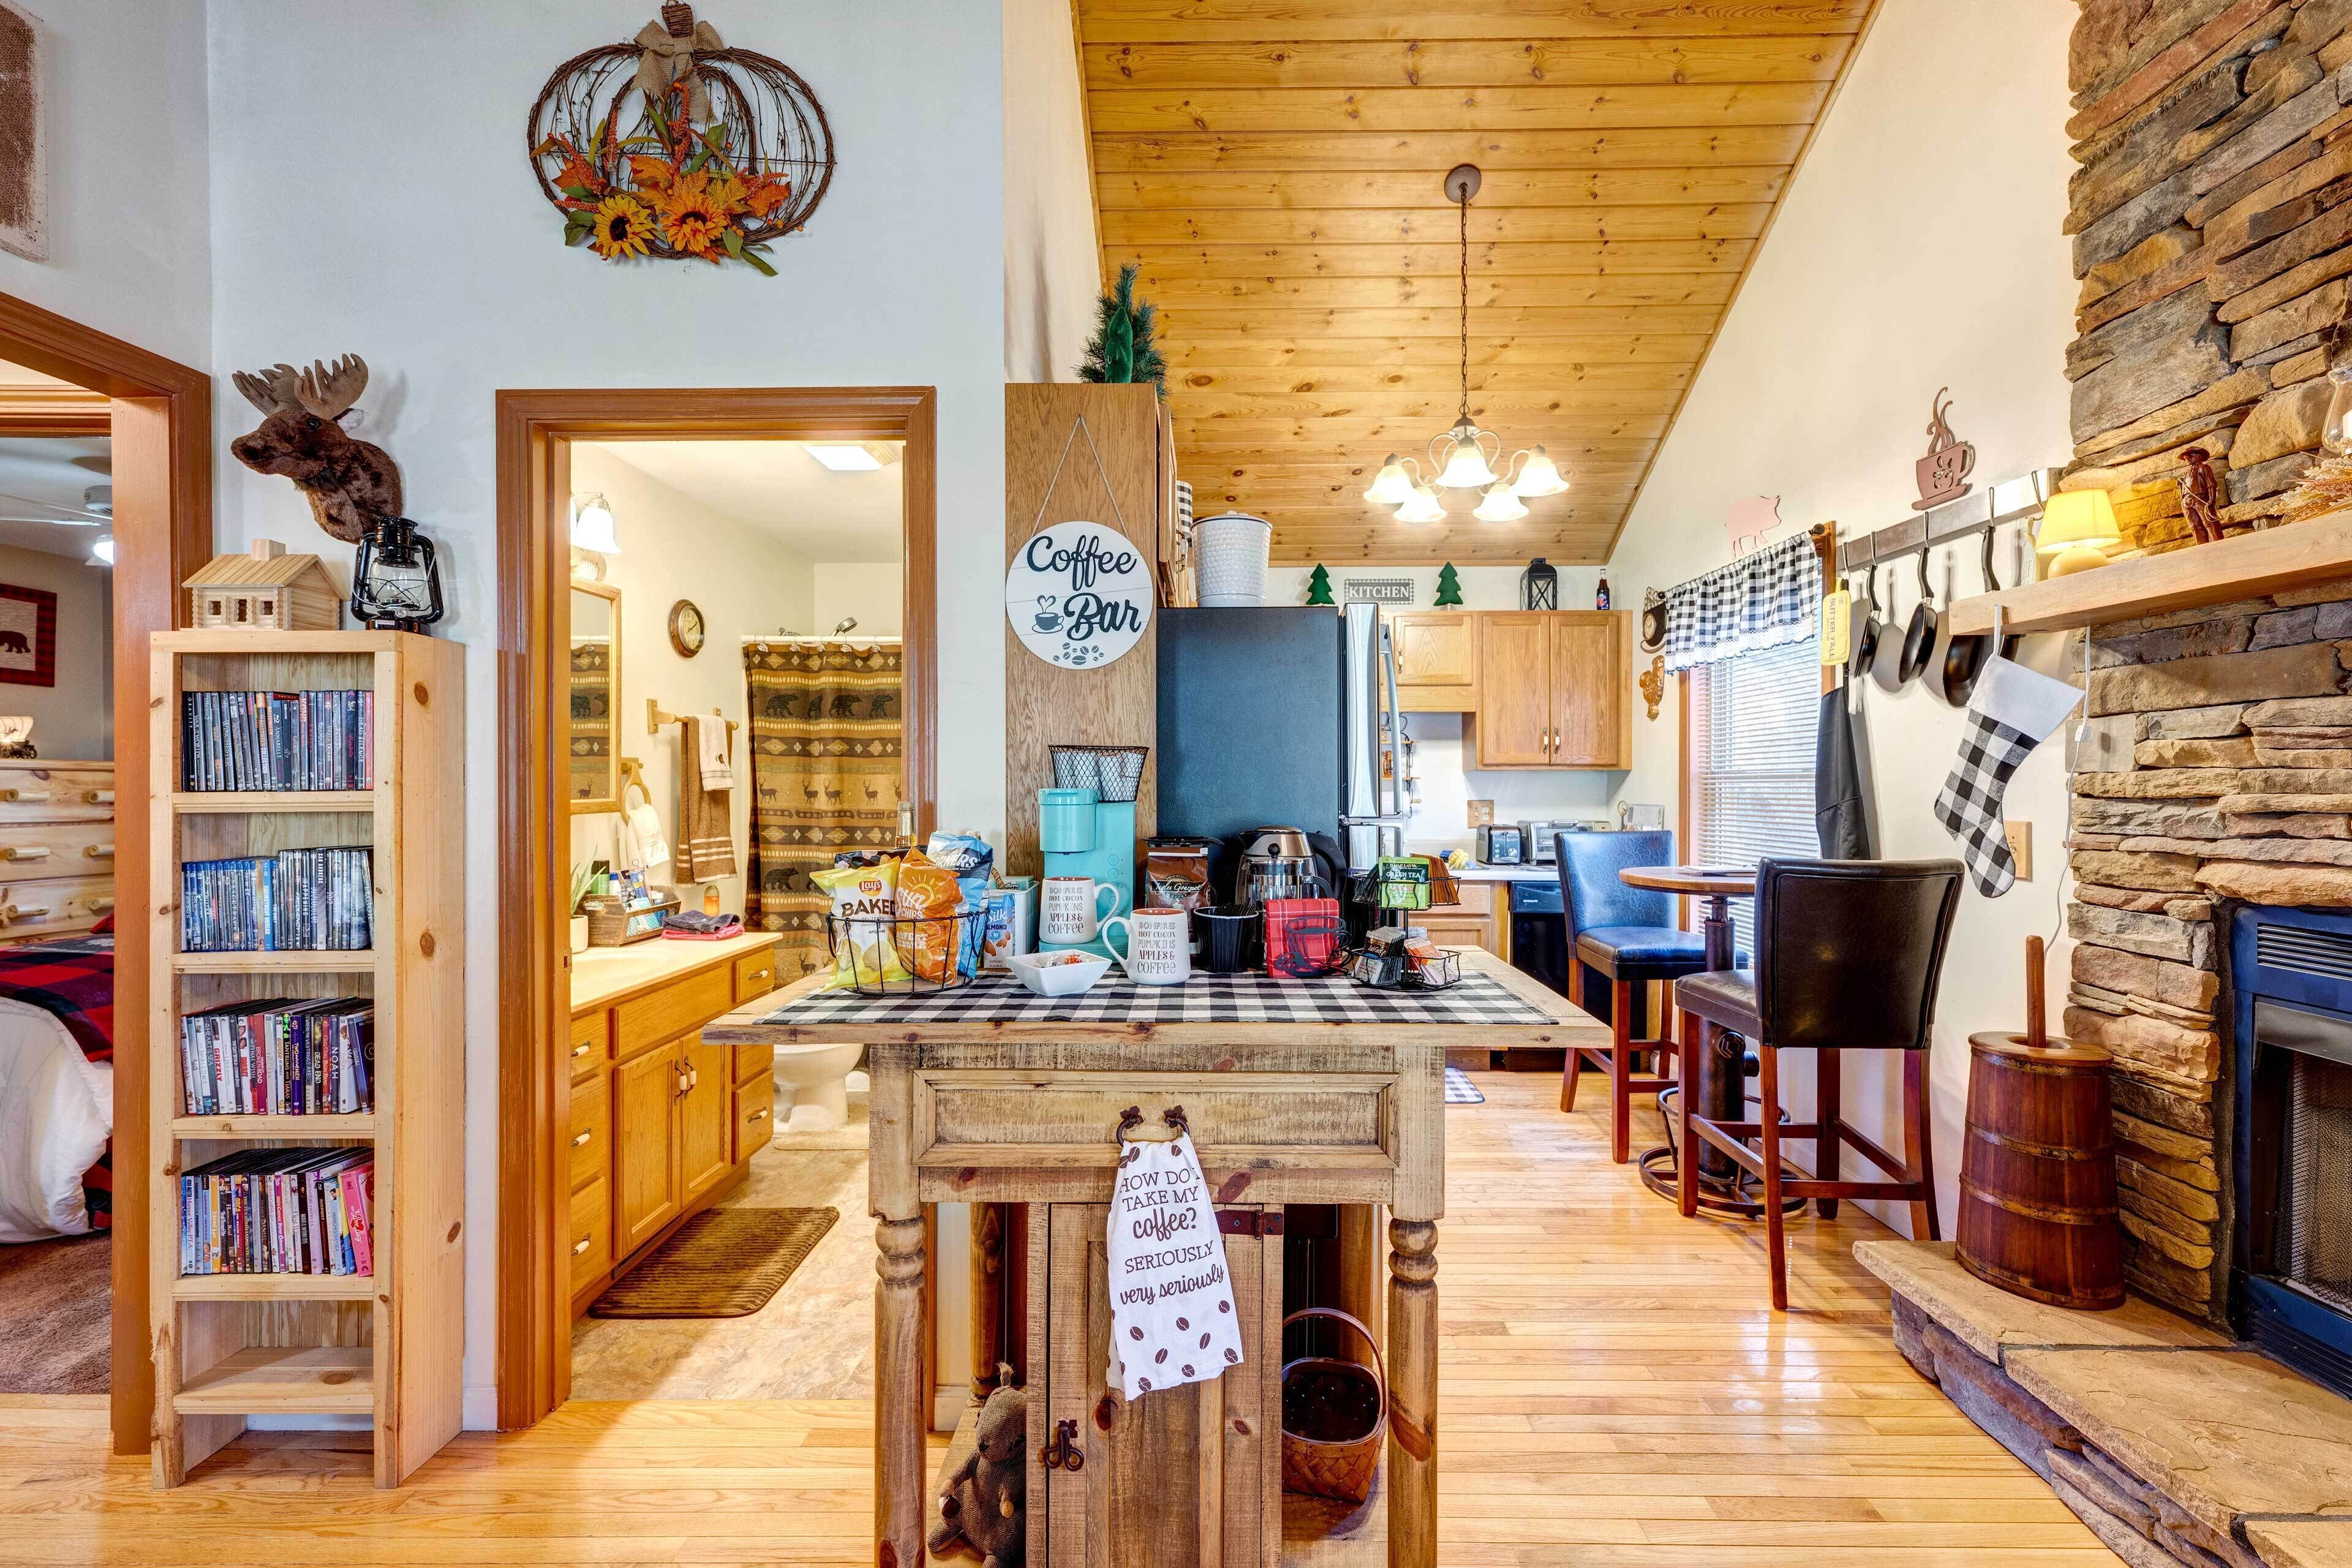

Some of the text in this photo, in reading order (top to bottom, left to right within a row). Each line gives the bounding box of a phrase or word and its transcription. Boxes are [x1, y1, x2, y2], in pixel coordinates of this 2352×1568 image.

[1027, 535, 1137, 591] Coffee
[1348, 586, 1409, 598] KITCHEN
[1063, 592, 1142, 641] Bar
[861, 881, 881, 891] Lay's
[987, 908, 1008, 924] Silk
[1049, 913, 1083, 922] APPLES &
[1139, 949, 1175, 960] APPLES &
[1165, 1168, 1190, 1185] DO
[1122, 1186, 1199, 1212] TAKE MY
[1133, 1207, 1197, 1242] coffee?
[353, 1226, 366, 1244] Lucy
[1125, 1240, 1213, 1274] SERIOUSLY
[1120, 1263, 1224, 1305] very seriously
